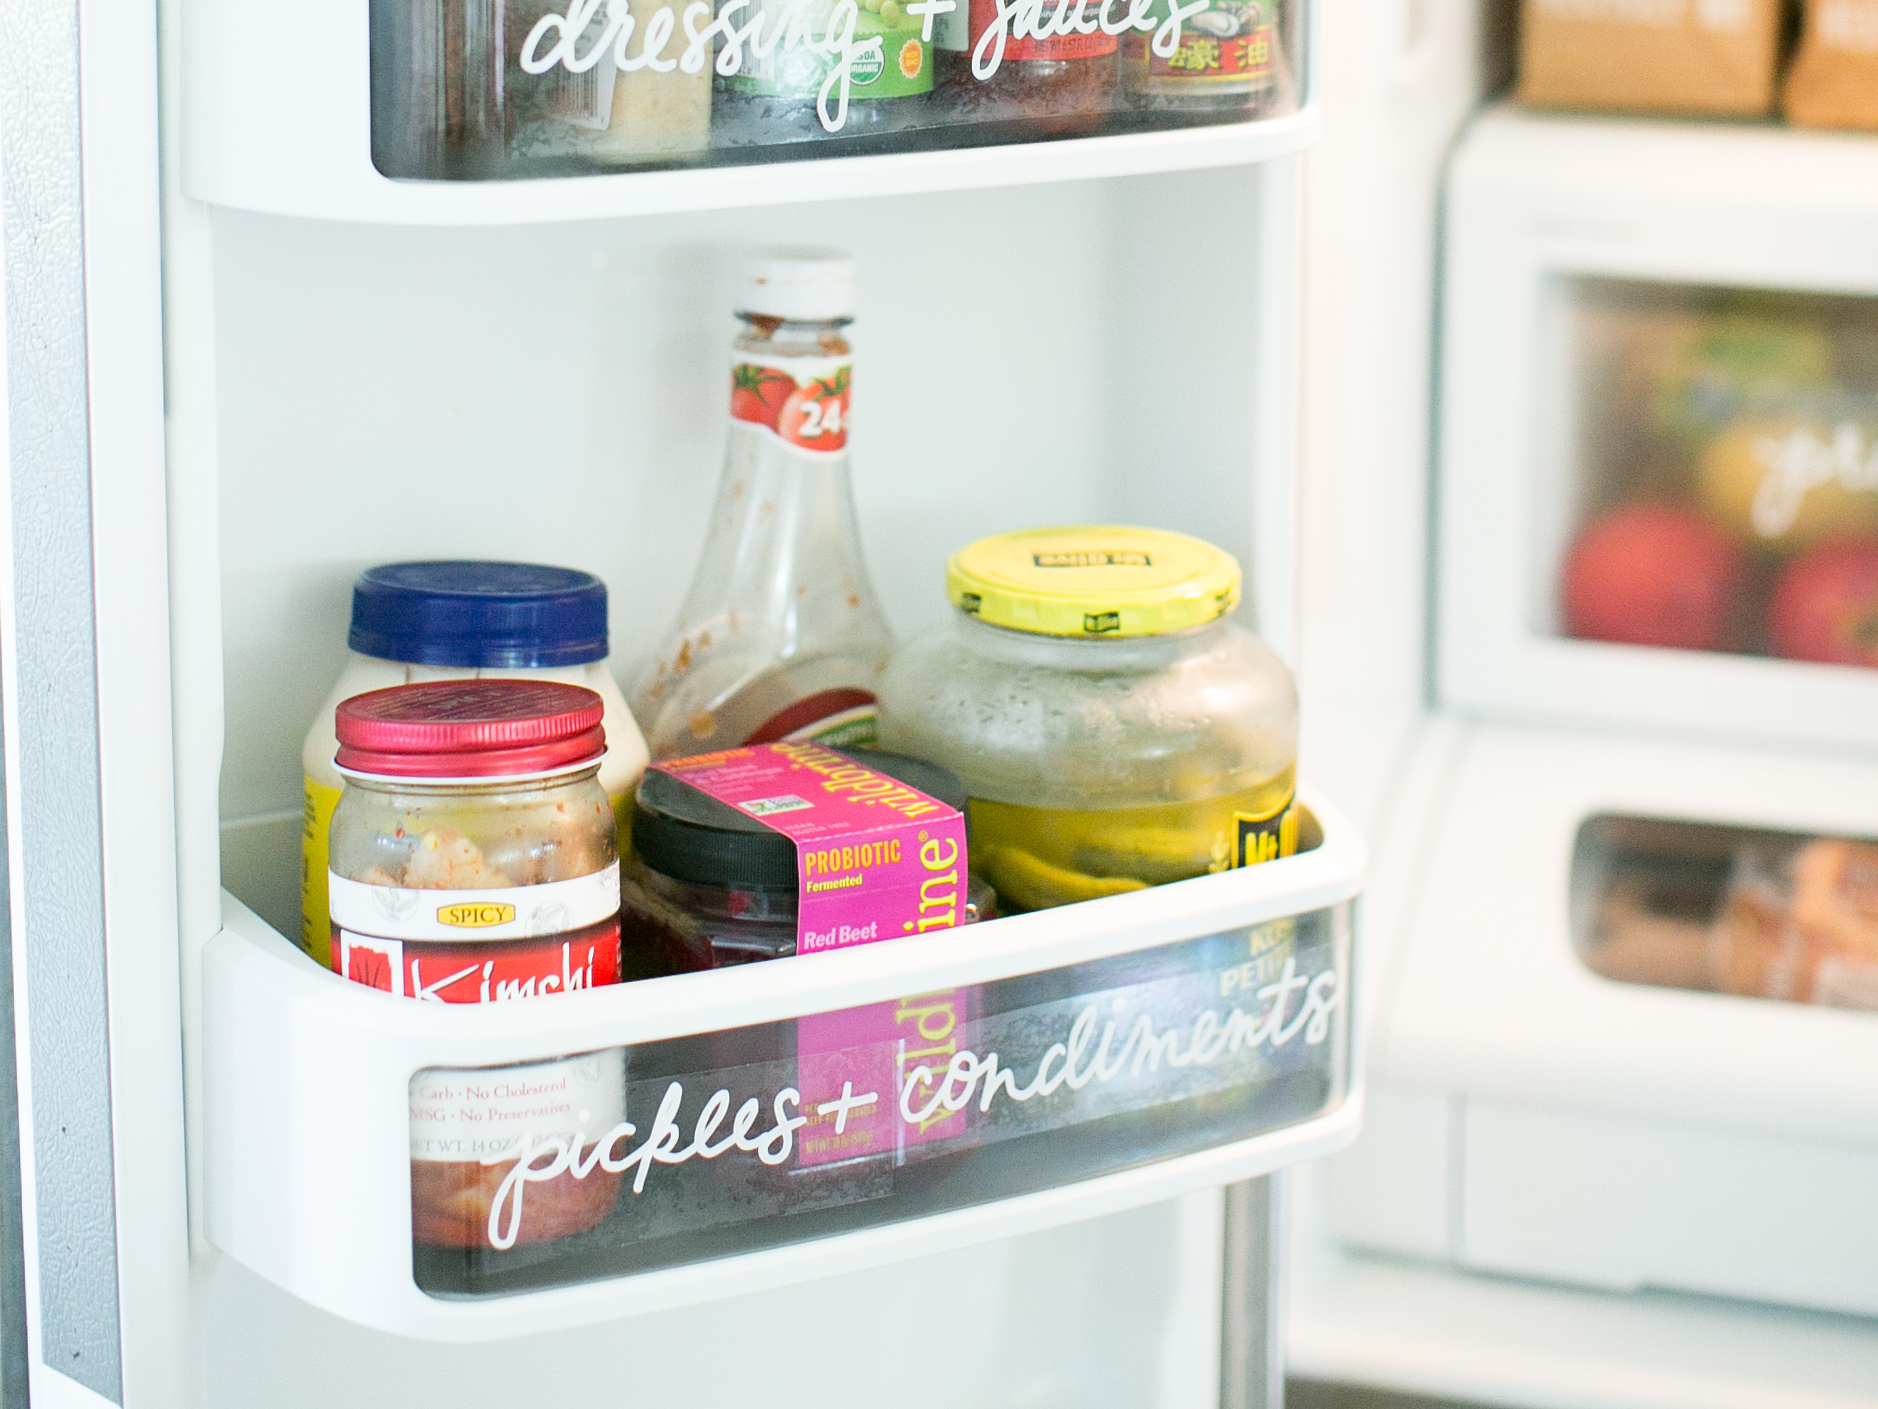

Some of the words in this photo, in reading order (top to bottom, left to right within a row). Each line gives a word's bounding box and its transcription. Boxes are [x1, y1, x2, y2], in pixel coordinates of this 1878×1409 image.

[853, 50, 876, 62] SDA
[805, 838, 902, 877] PROBIOTIC
[806, 873, 863, 895] Fermented
[449, 905, 508, 924] SPICY
[804, 930, 836, 951] Red
[838, 921, 878, 943] Beet
[410, 942, 596, 1004] Kimchi
[419, 1085, 454, 1101] Carb
[466, 1087, 490, 1101] No
[493, 1077, 567, 1100] Cholesterol
[459, 1109, 483, 1122] No
[487, 1101, 571, 1122] Preservatives
[478, 1081, 808, 1251] pickles
[817, 1081, 879, 1135] +
[900, 955, 1339, 1125] condiments
[412, 1139, 433, 1153] ET
[438, 1139, 467, 1153] WT.
[472, 1139, 487, 1153] 14
